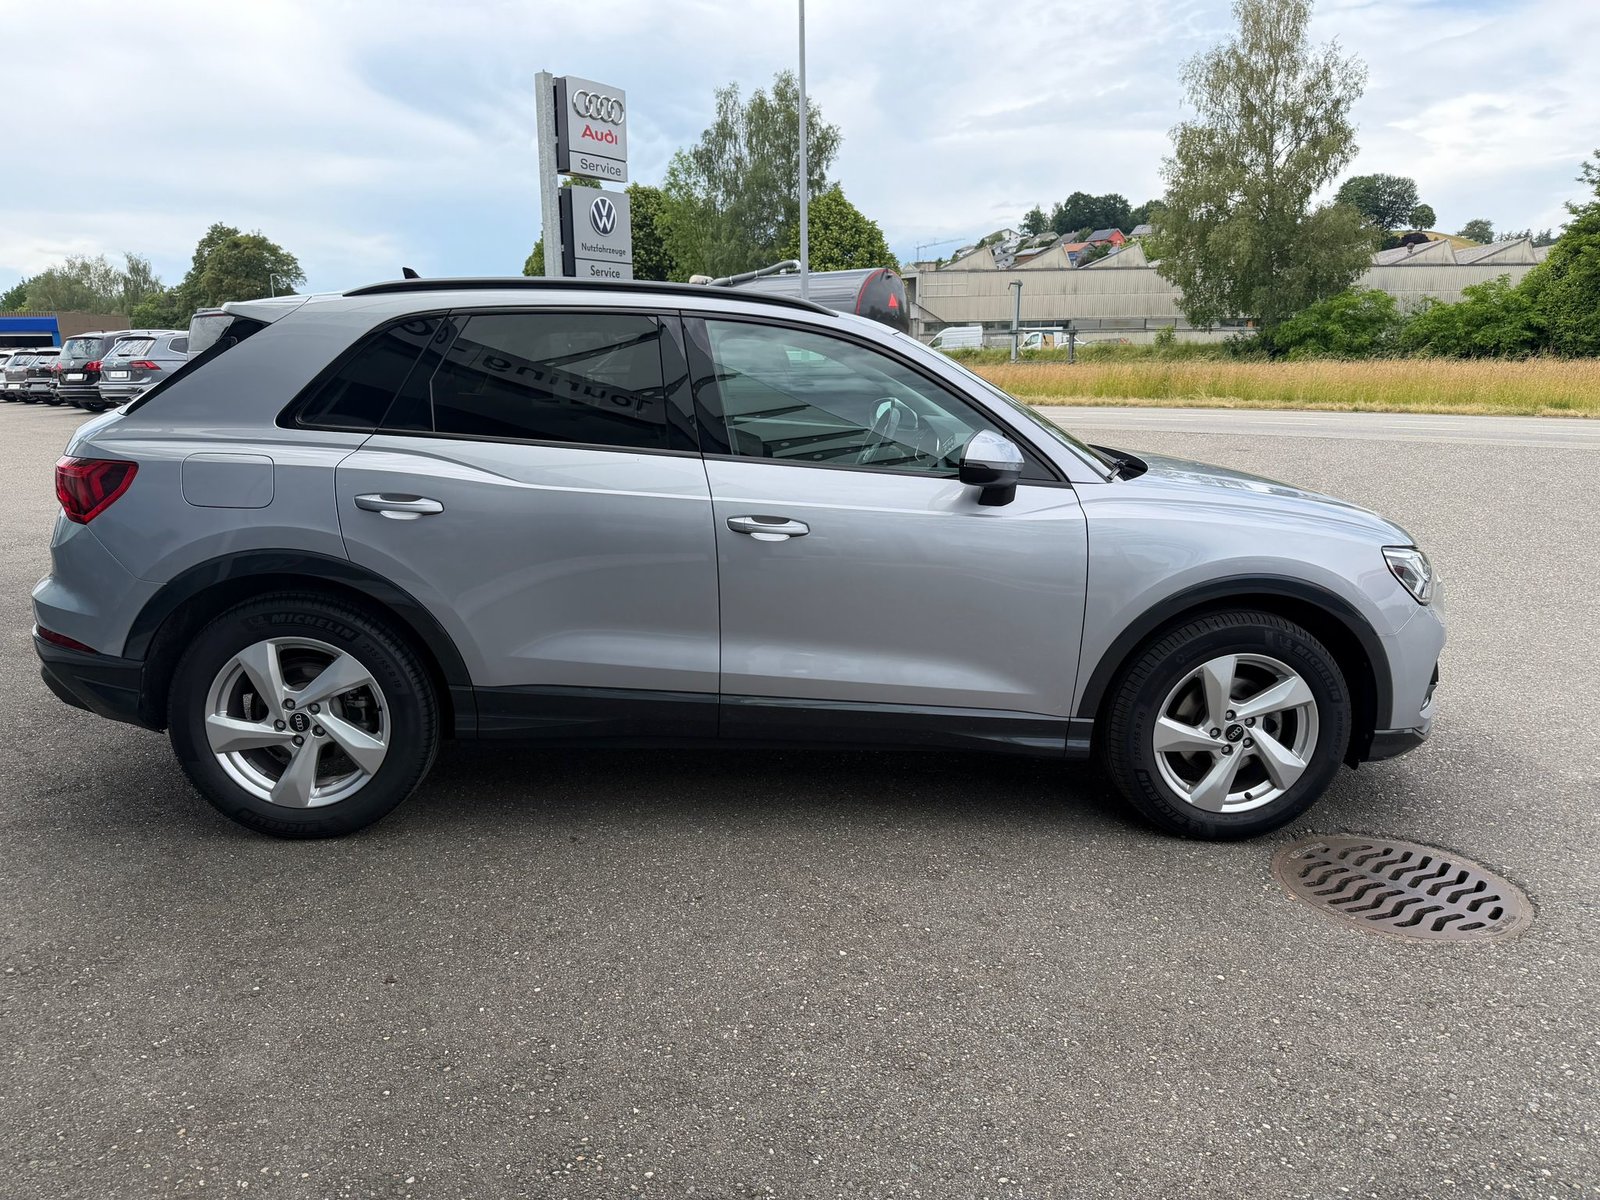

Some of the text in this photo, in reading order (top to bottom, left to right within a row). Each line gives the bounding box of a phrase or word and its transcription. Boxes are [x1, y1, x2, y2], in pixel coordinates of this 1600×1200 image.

[581, 124, 618, 145] Audi
[580, 158, 621, 176] Service
[581, 242, 627, 257] Nutzfahrzeuge
[590, 264, 621, 279] Service
[272, 613, 355, 640] MICHELIN
